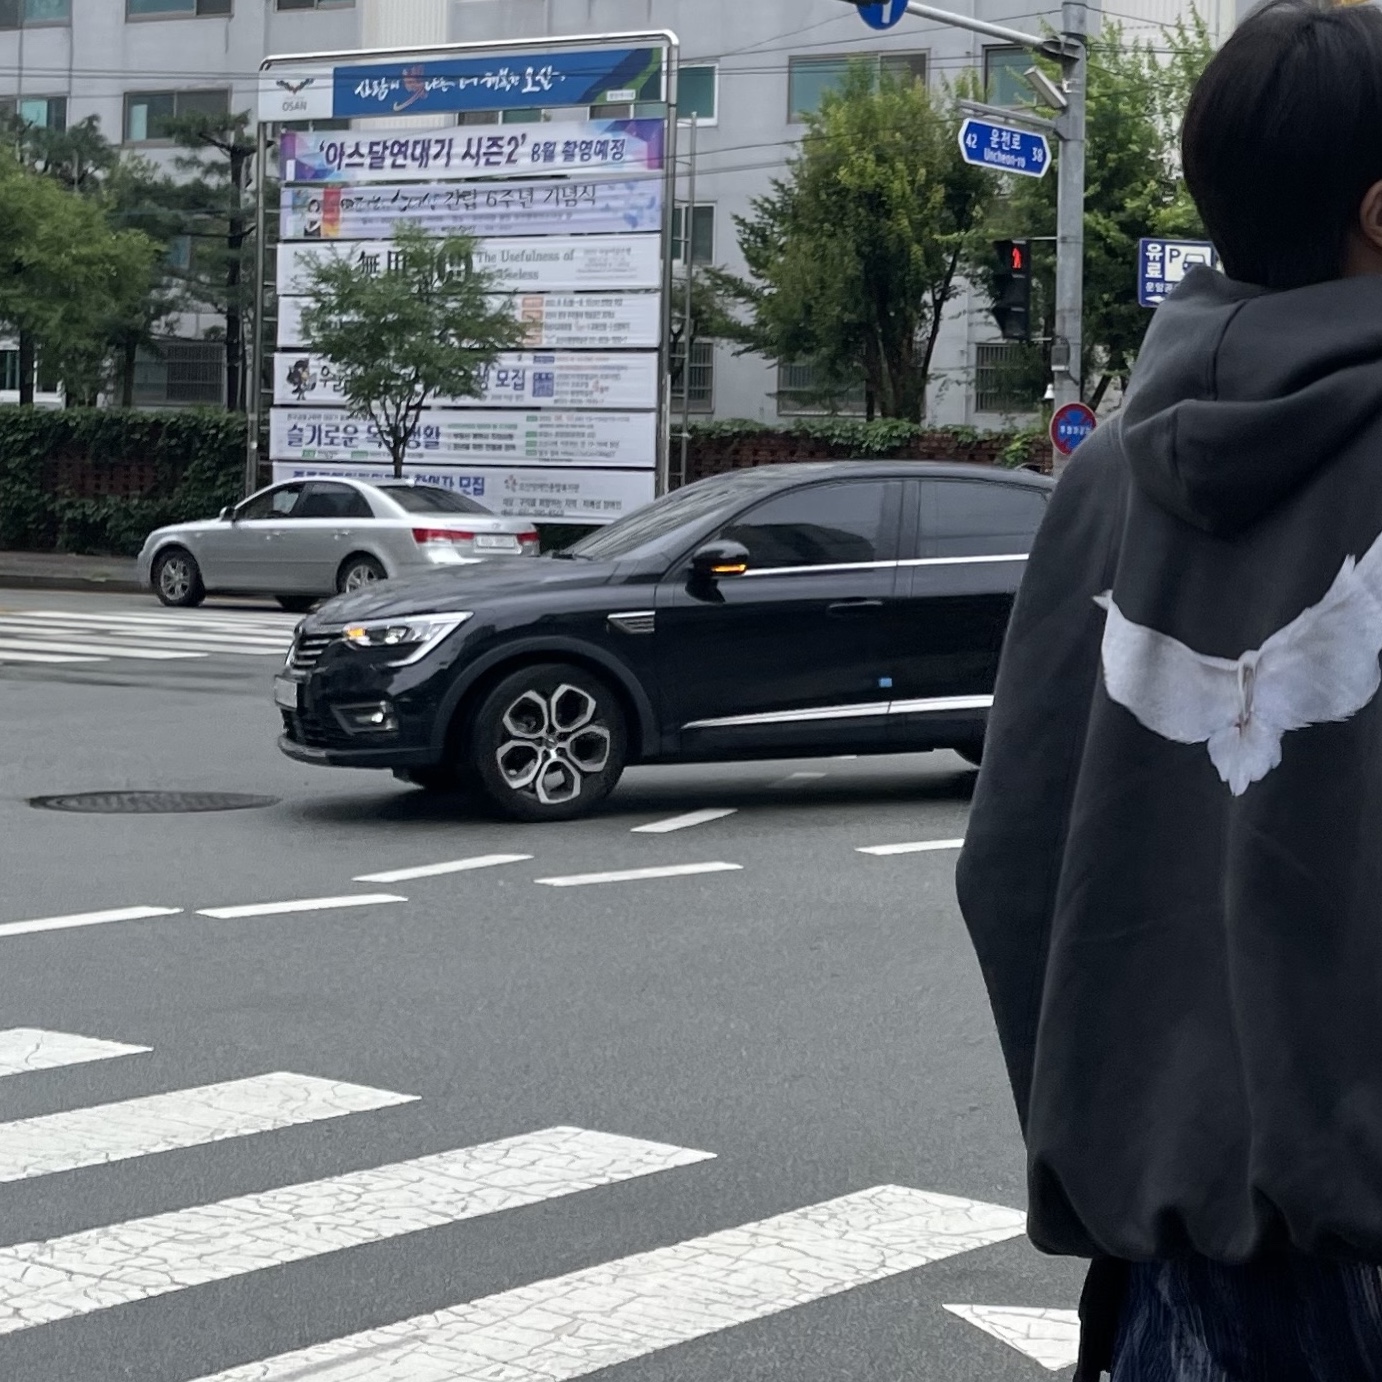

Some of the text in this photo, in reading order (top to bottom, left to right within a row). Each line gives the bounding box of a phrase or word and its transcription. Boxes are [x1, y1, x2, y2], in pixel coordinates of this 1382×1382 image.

[282, 100, 308, 112] OSAN
[965, 132, 978, 149] 42
[989, 128, 1021, 151] 운천로
[531, 142, 557, 164] 8월
[562, 138, 627, 163] 촬영예정
[983, 147, 1026, 168] Uncheon-ro
[1032, 146, 1044, 163] 38
[486, 187, 534, 208] 6주년
[543, 183, 597, 207] 기념식
[476, 251, 497, 264] The
[501, 249, 560, 264] Usefulness
[563, 249, 575, 261] of
[1145, 243, 1163, 278] 유료
[1169, 248, 1181, 264] P
[495, 369, 526, 391] 모집
[287, 423, 359, 449] 슬기로운
[459, 476, 485, 496] 모집
